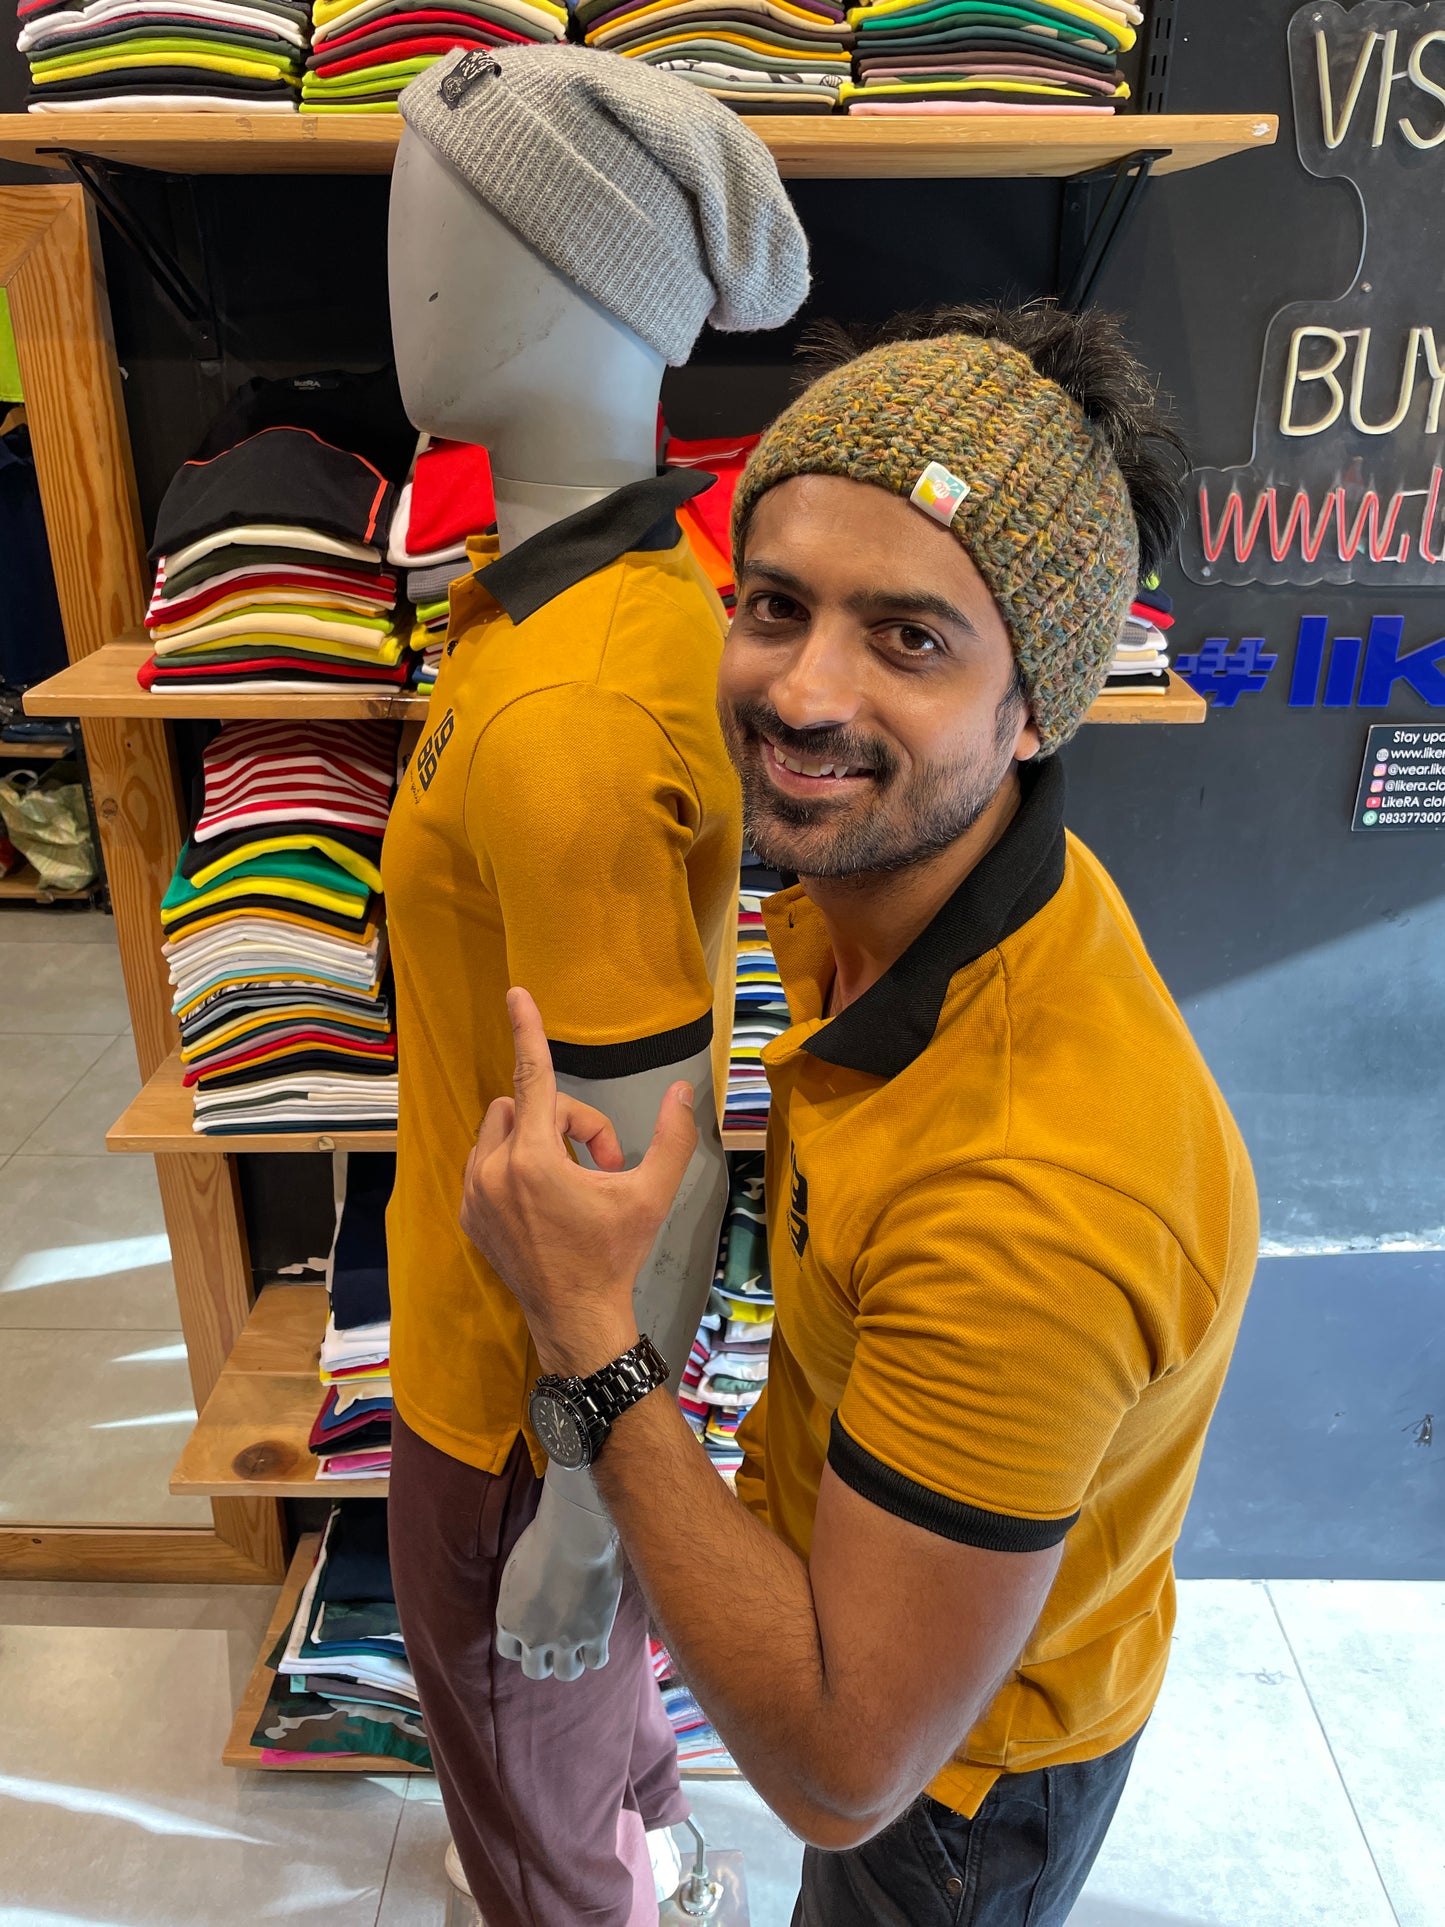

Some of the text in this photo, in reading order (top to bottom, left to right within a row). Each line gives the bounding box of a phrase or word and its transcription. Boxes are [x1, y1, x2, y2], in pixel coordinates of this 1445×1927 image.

[1279, 326, 1445, 437] BUY
[1393, 731, 1420, 745] Stay
[1381, 796, 1420, 808] LikeRA
